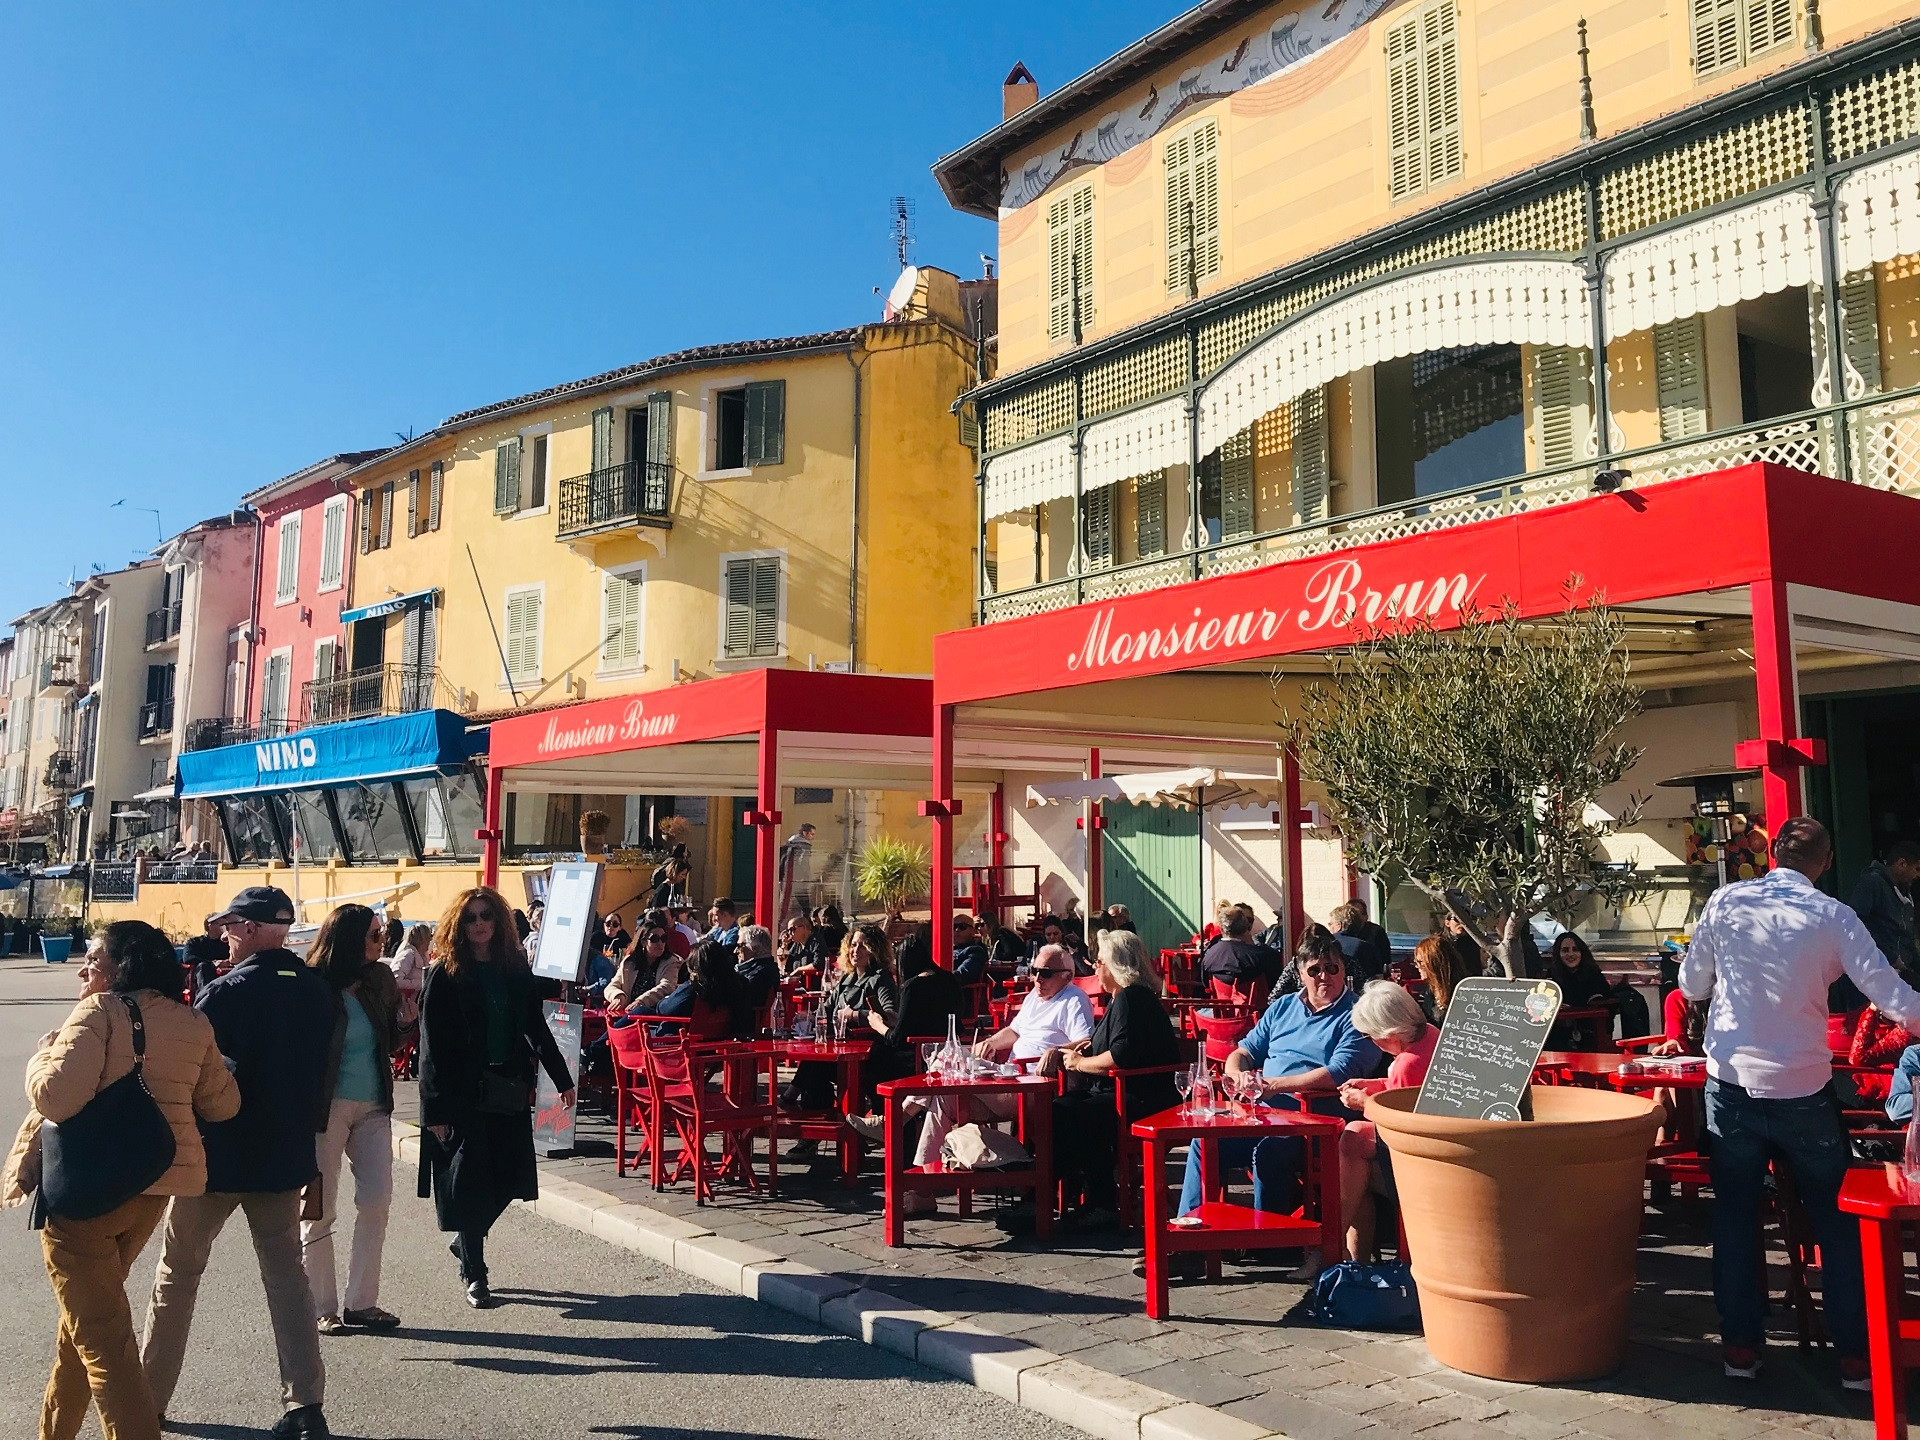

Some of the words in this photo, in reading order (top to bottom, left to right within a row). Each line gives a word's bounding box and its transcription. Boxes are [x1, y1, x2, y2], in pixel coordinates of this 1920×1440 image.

[365, 601, 407, 618] NINO
[1068, 607, 1289, 671] Monsieur
[1298, 559, 1486, 632] Brun
[538, 716, 618, 754] Monsieur
[620, 699, 680, 740] Brun
[255, 738, 316, 773] NINO
